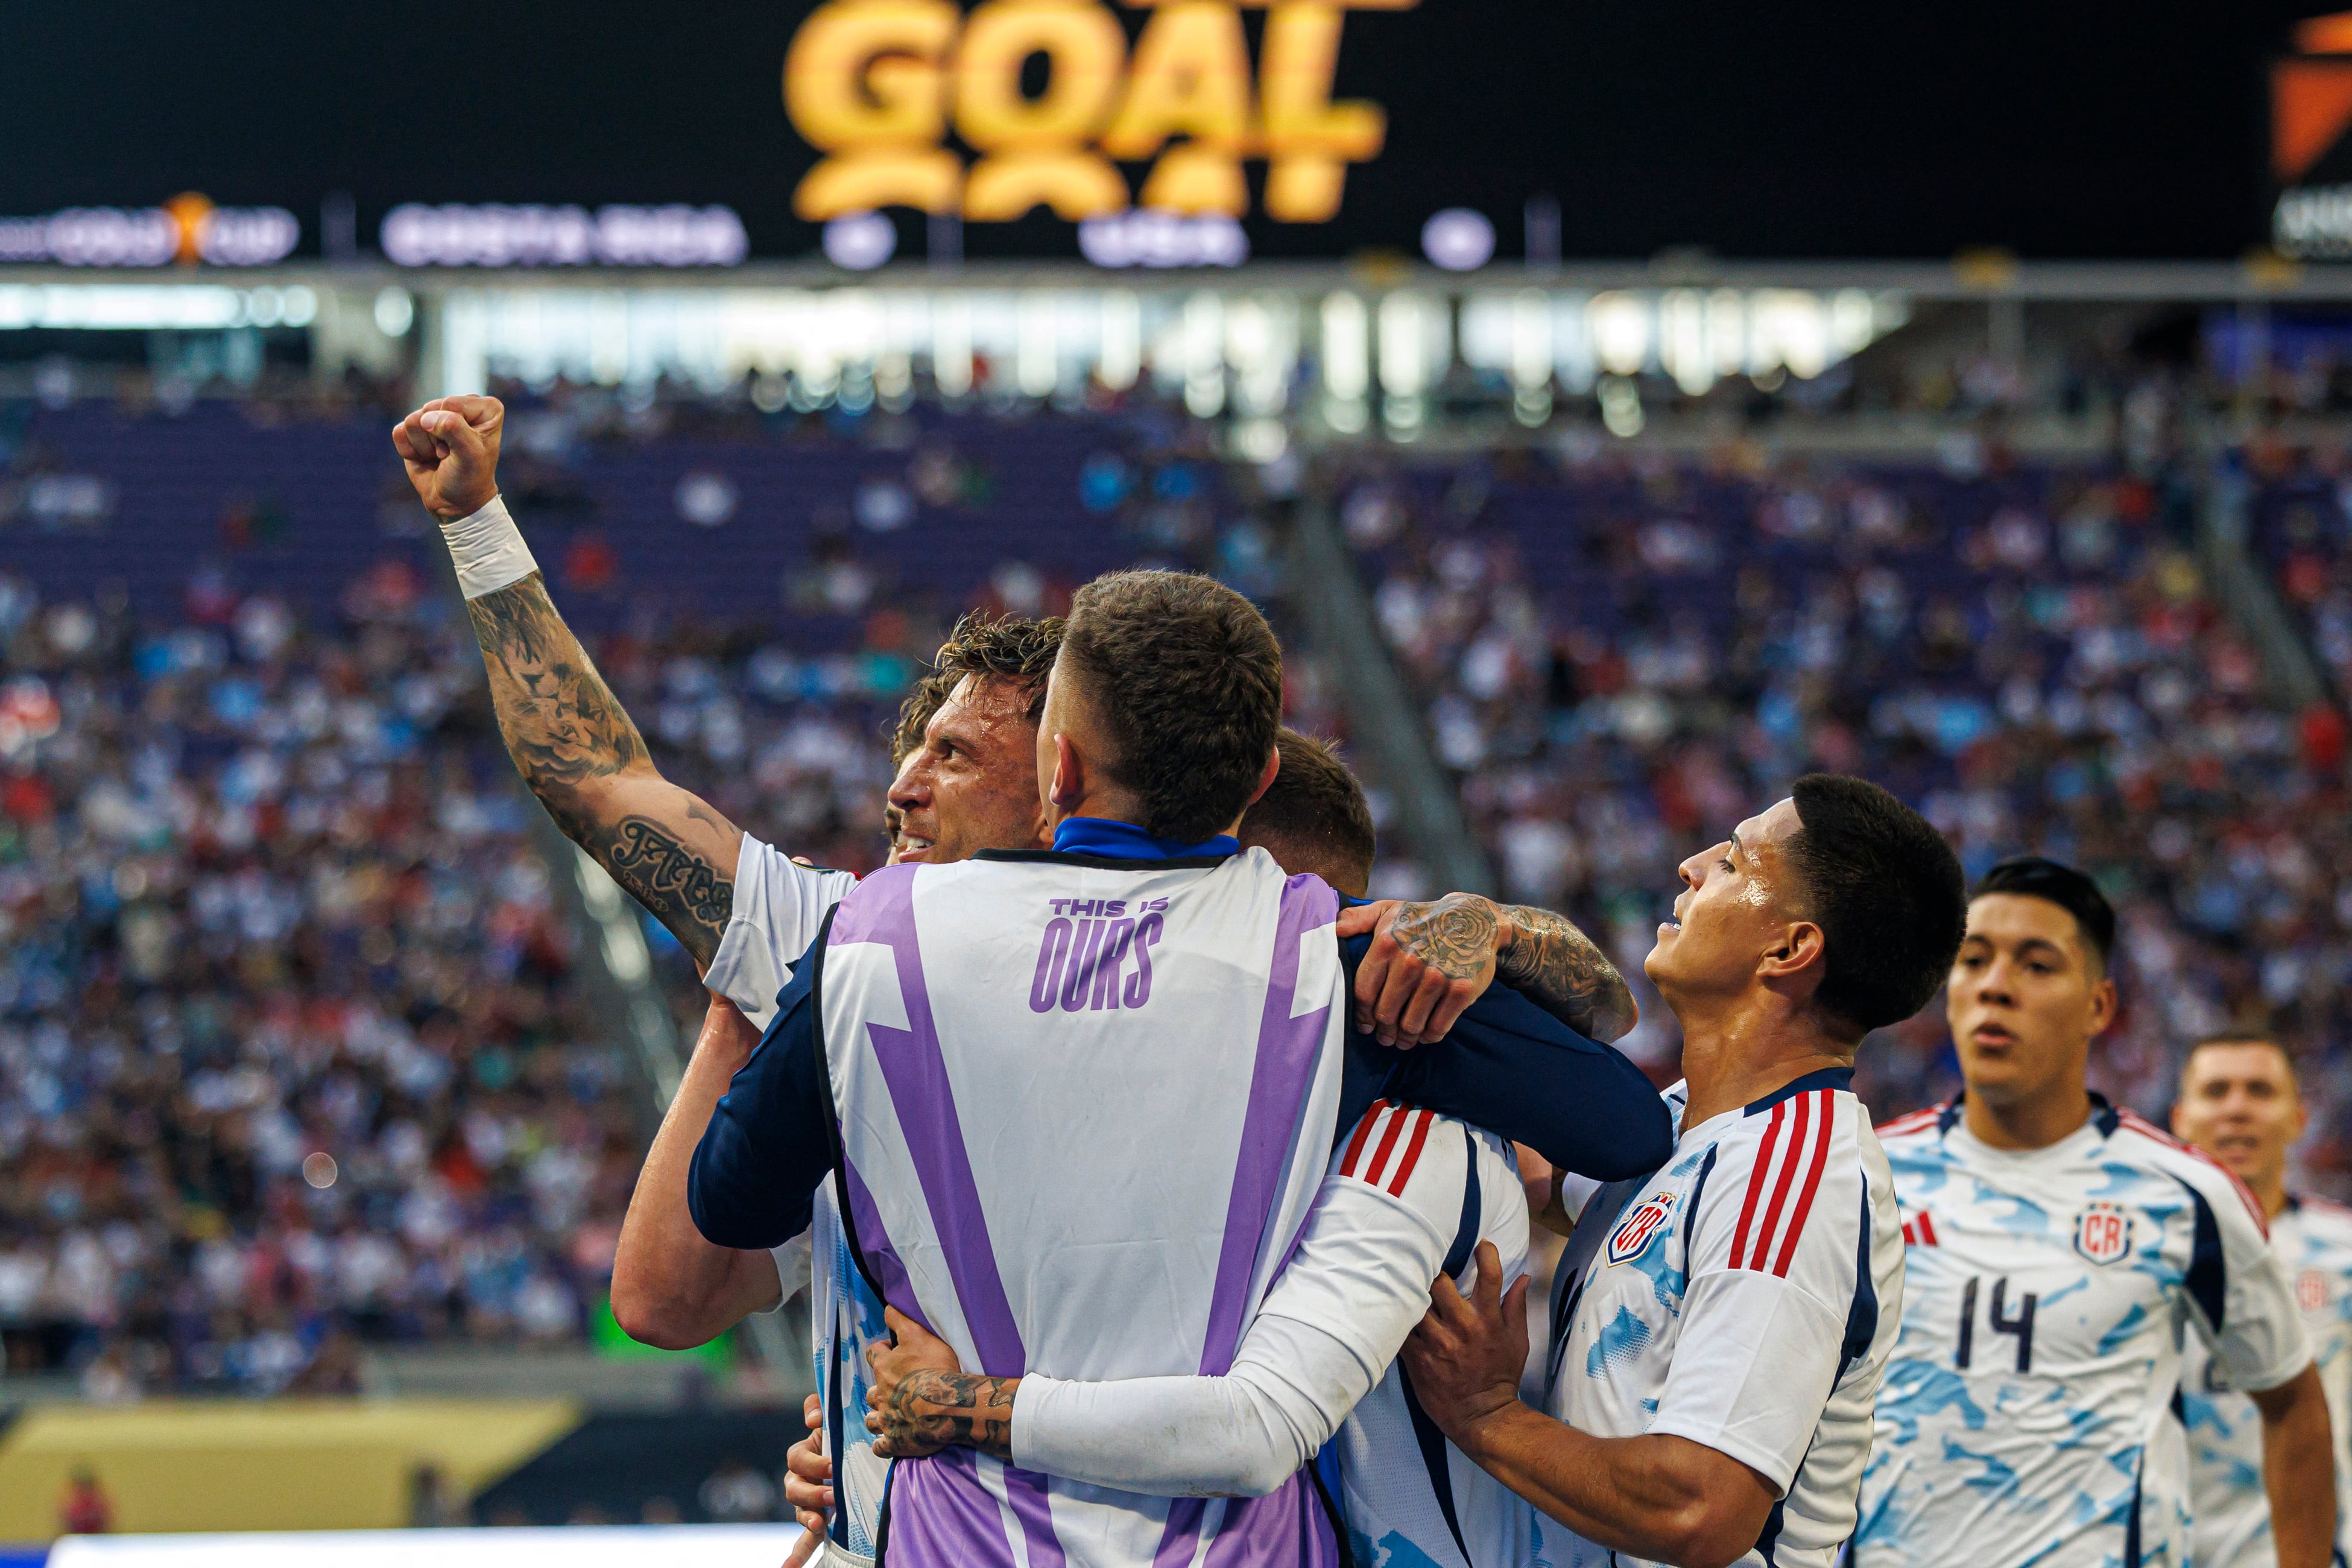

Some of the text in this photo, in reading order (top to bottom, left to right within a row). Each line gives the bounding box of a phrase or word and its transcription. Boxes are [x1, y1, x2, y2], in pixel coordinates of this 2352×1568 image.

[783, 0, 1386, 161] GOAL
[1049, 897, 1169, 917] THIS IS
[1029, 912, 1164, 1013] OURS
[1617, 1207, 1662, 1252] CR
[2085, 1214, 2122, 1256] CR
[1956, 1276, 2037, 1373] 14
